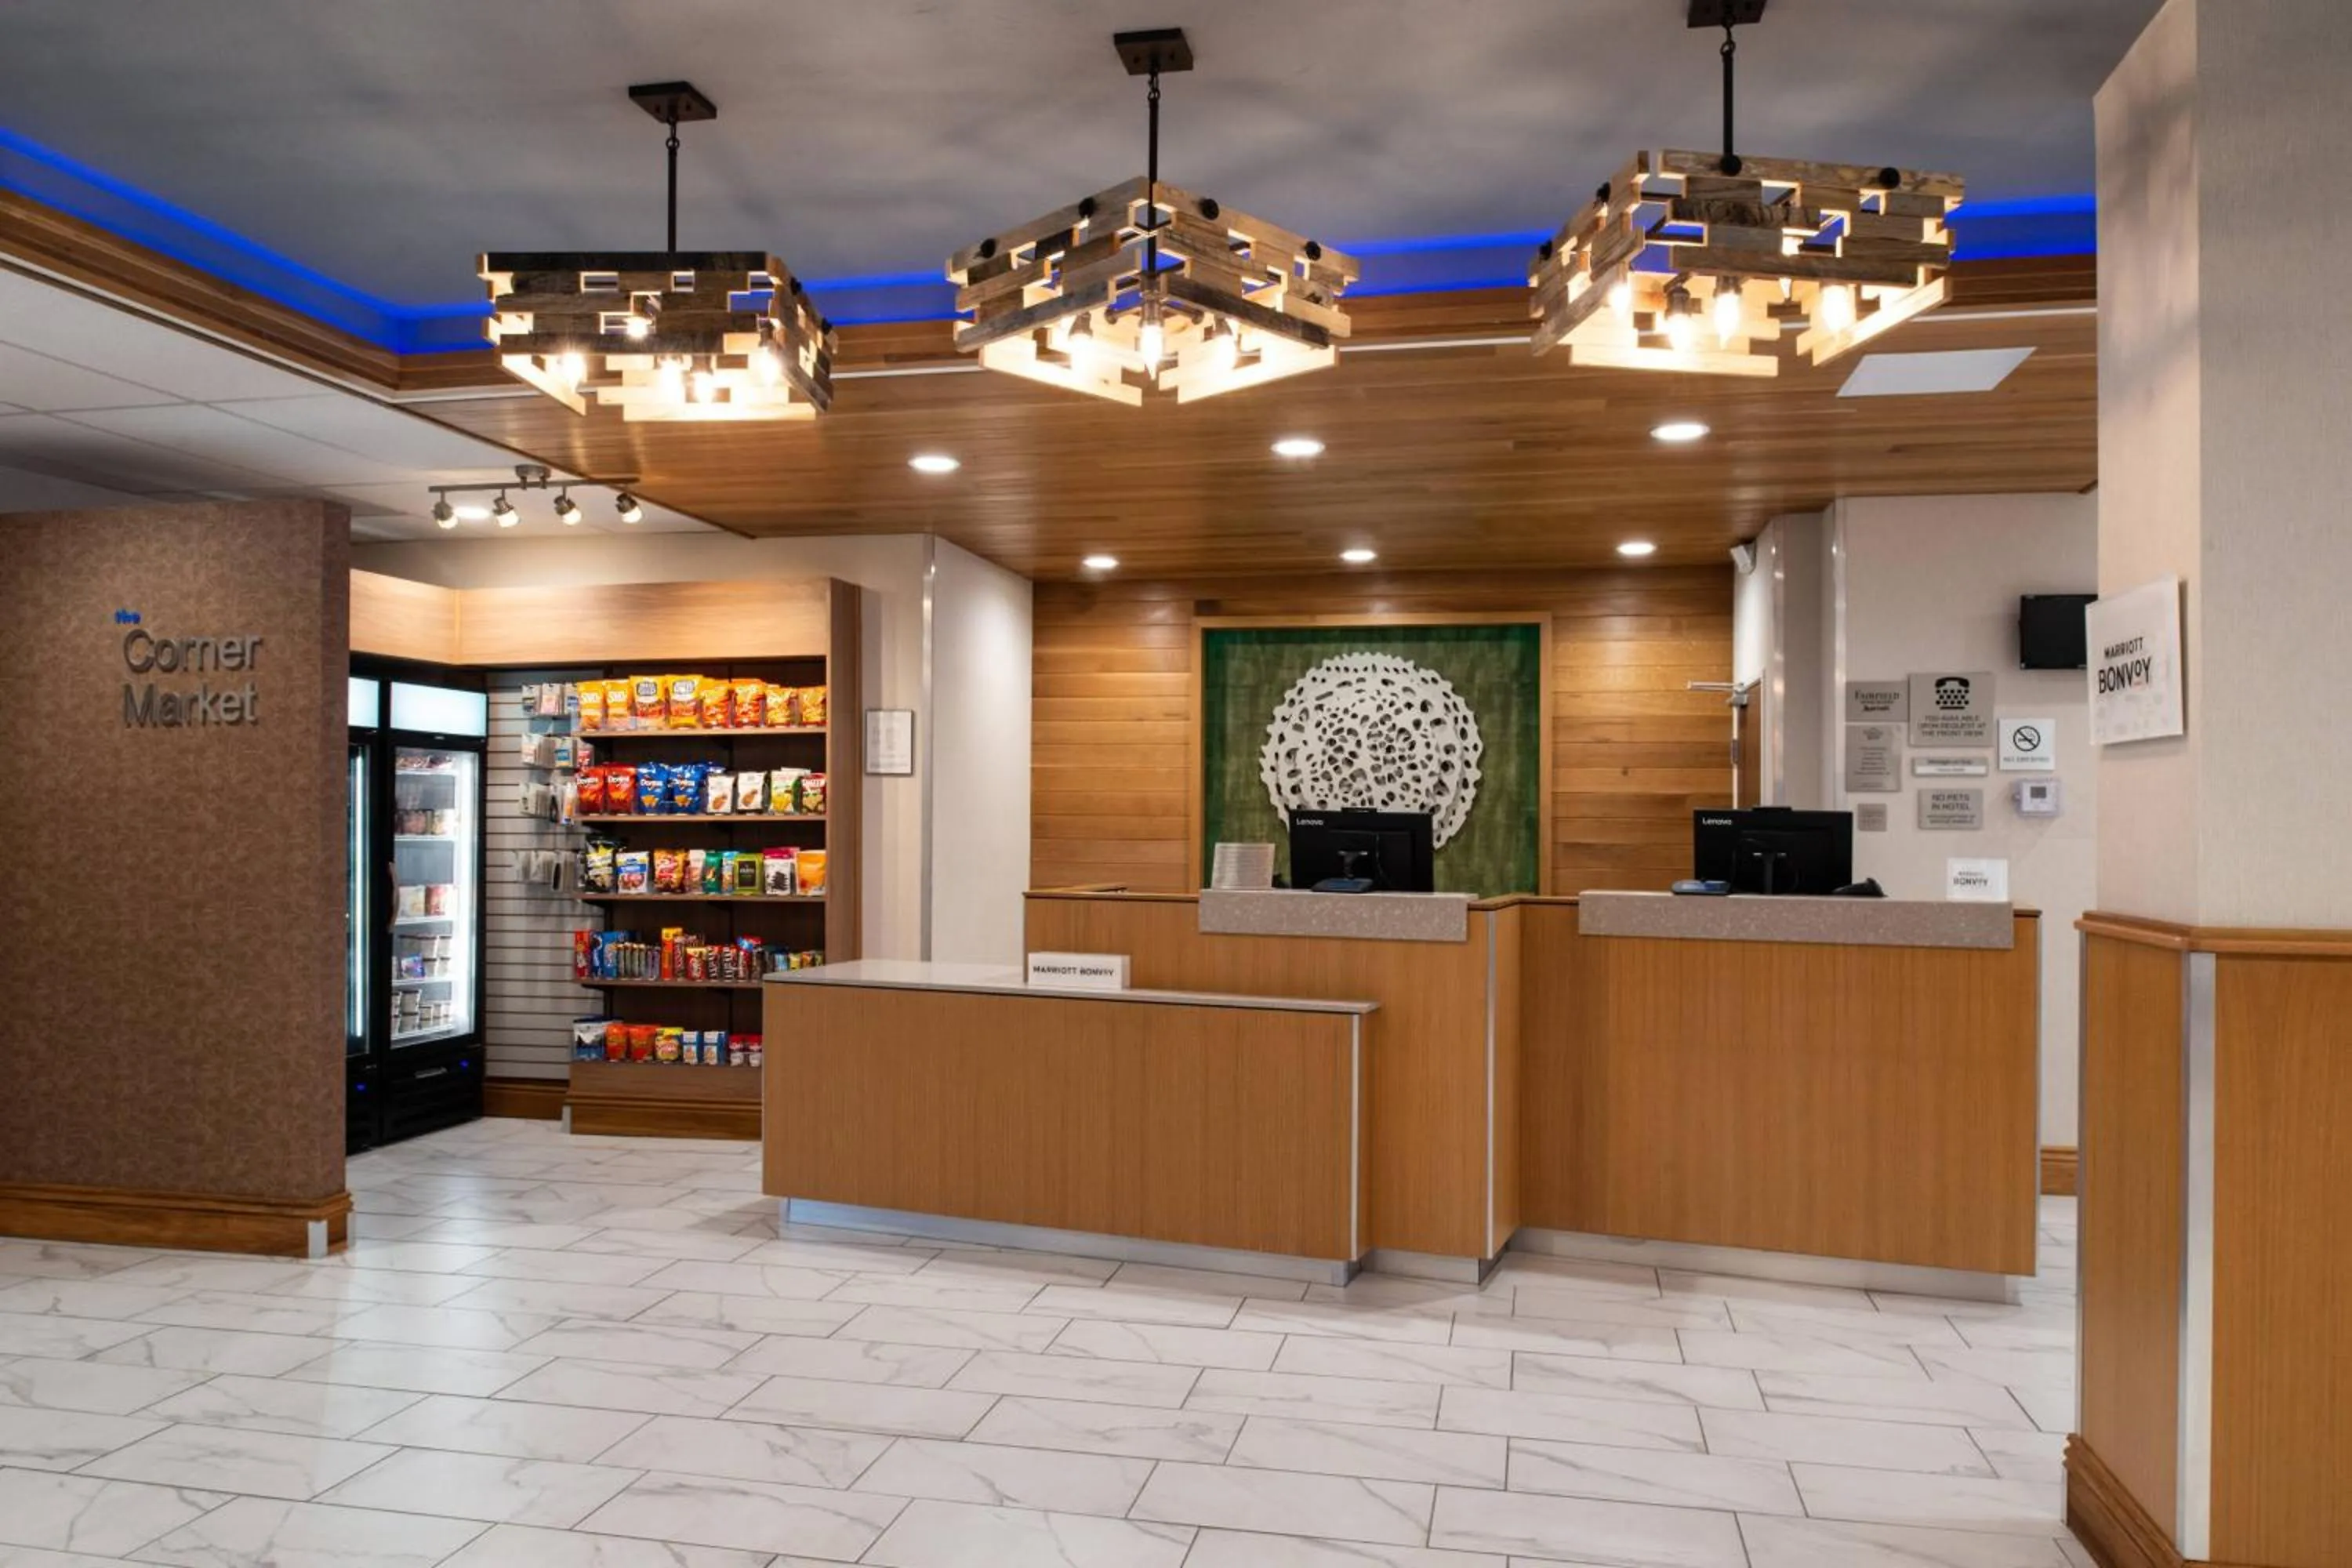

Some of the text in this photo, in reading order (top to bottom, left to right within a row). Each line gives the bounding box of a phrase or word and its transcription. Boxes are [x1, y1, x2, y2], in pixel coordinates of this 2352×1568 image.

[123, 629, 263, 673] Corner
[2104, 637, 2144, 659] MARRIOTT
[2098, 657, 2151, 693] BONVOY
[122, 683, 260, 728] Market
[1033, 965, 1114, 977] MARRIOTT BONVOY
